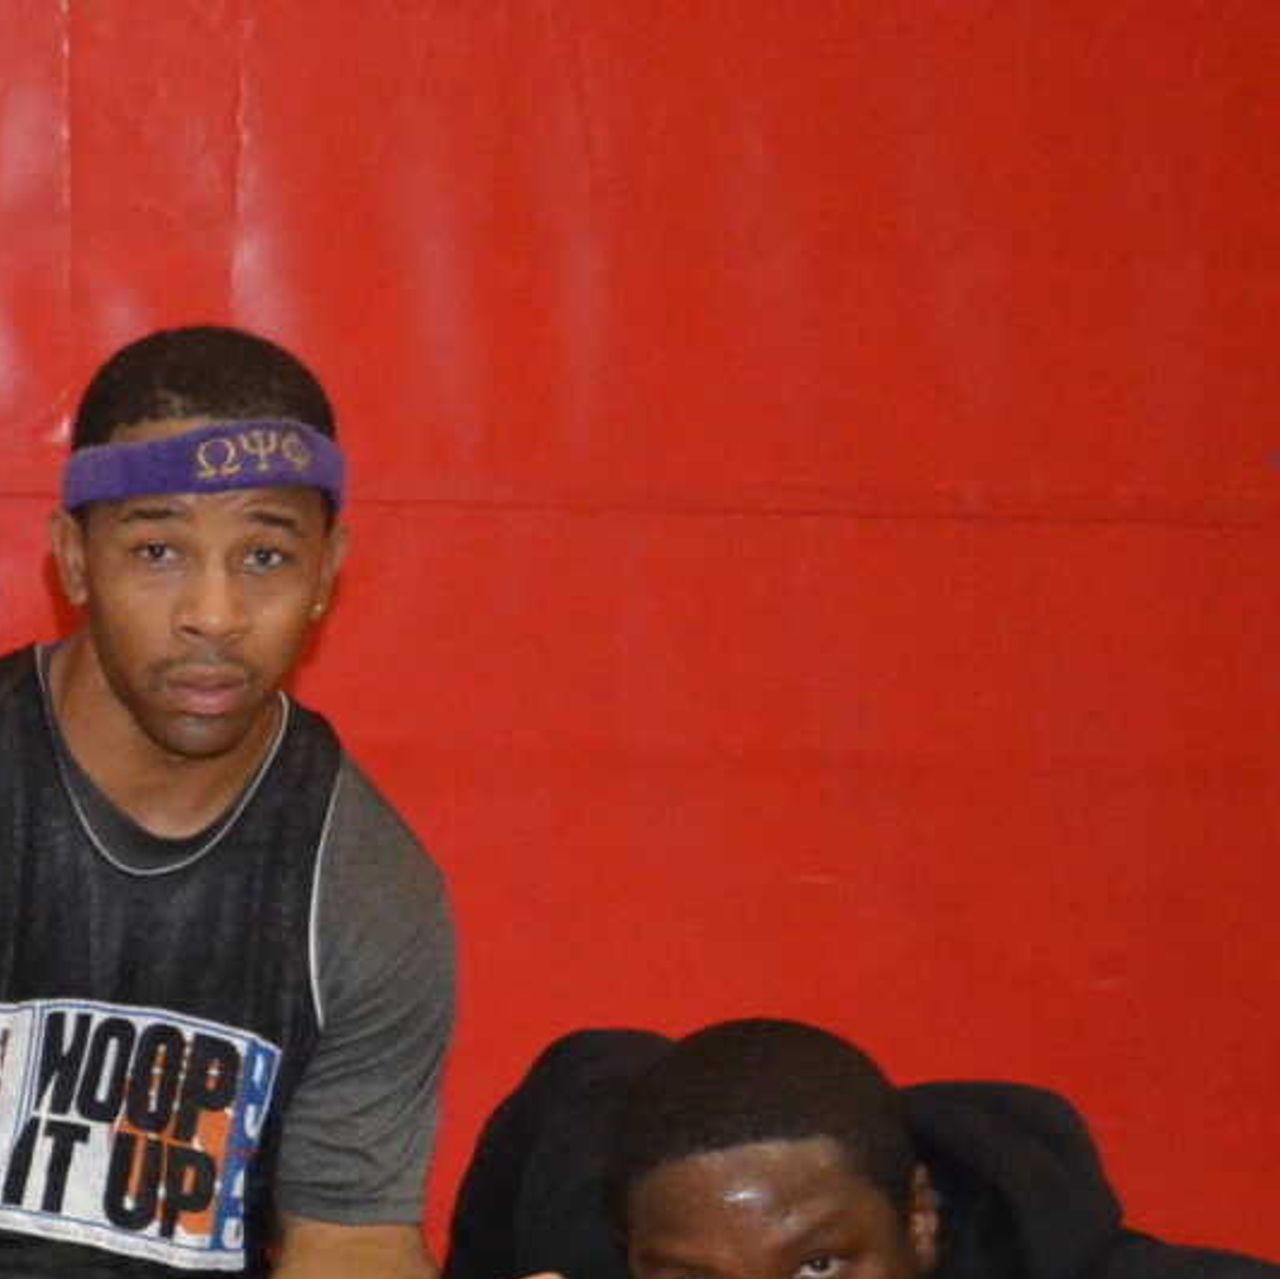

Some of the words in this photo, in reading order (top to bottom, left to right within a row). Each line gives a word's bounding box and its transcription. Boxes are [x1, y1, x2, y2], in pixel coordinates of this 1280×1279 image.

[33, 1011, 241, 1140] HOOP
[2, 1115, 90, 1213] IT
[103, 1132, 217, 1239] UP
